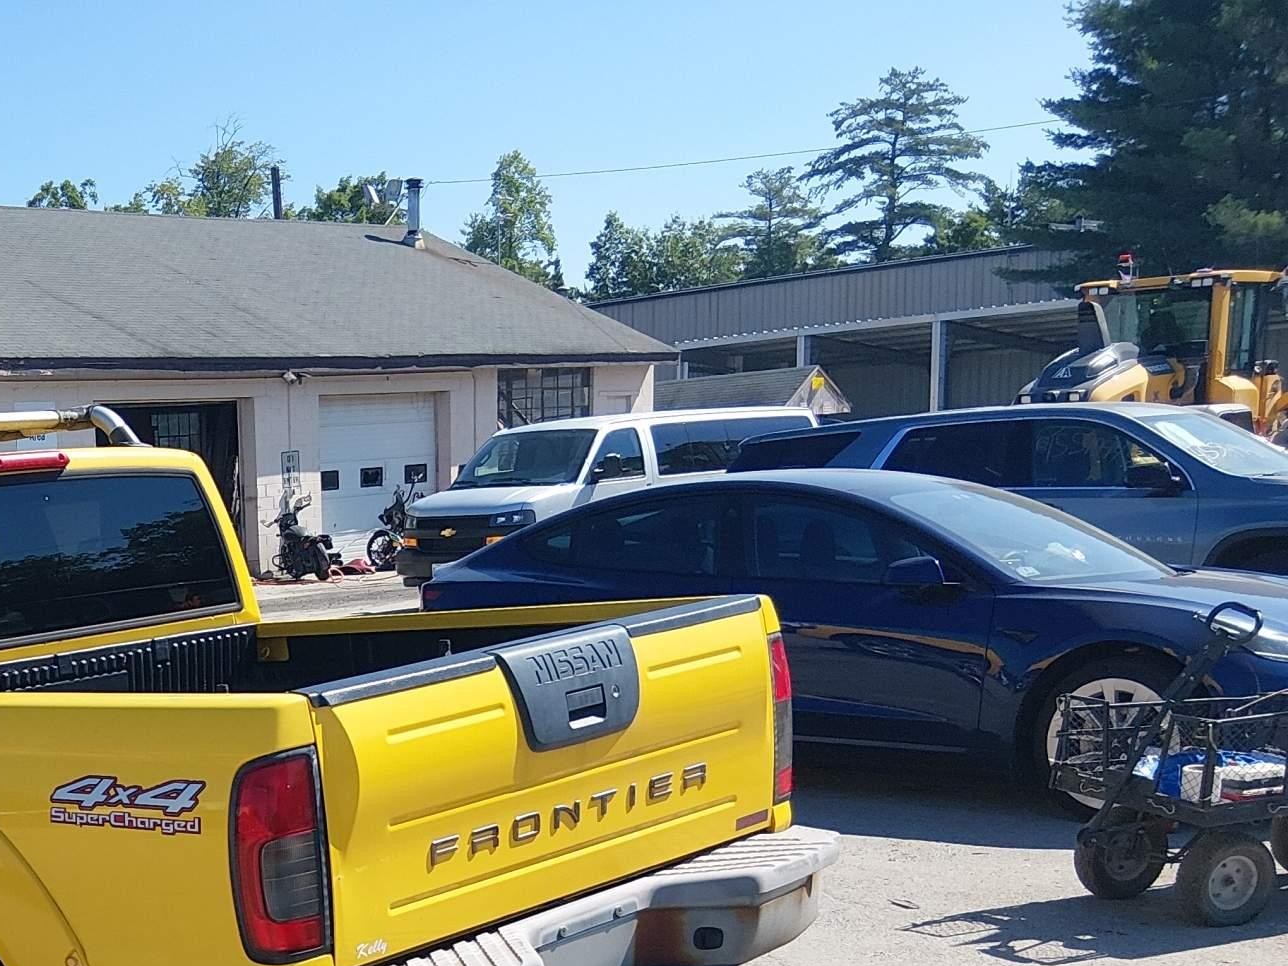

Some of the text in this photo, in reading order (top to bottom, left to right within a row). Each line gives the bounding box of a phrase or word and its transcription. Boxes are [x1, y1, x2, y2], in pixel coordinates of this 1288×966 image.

[526, 639, 623, 687] NISSAN
[50, 775, 206, 816] 4x4
[429, 762, 707, 868] FRONTIER
[50, 807, 202, 835] SuperCharged
[356, 938, 388, 960] Kelly
